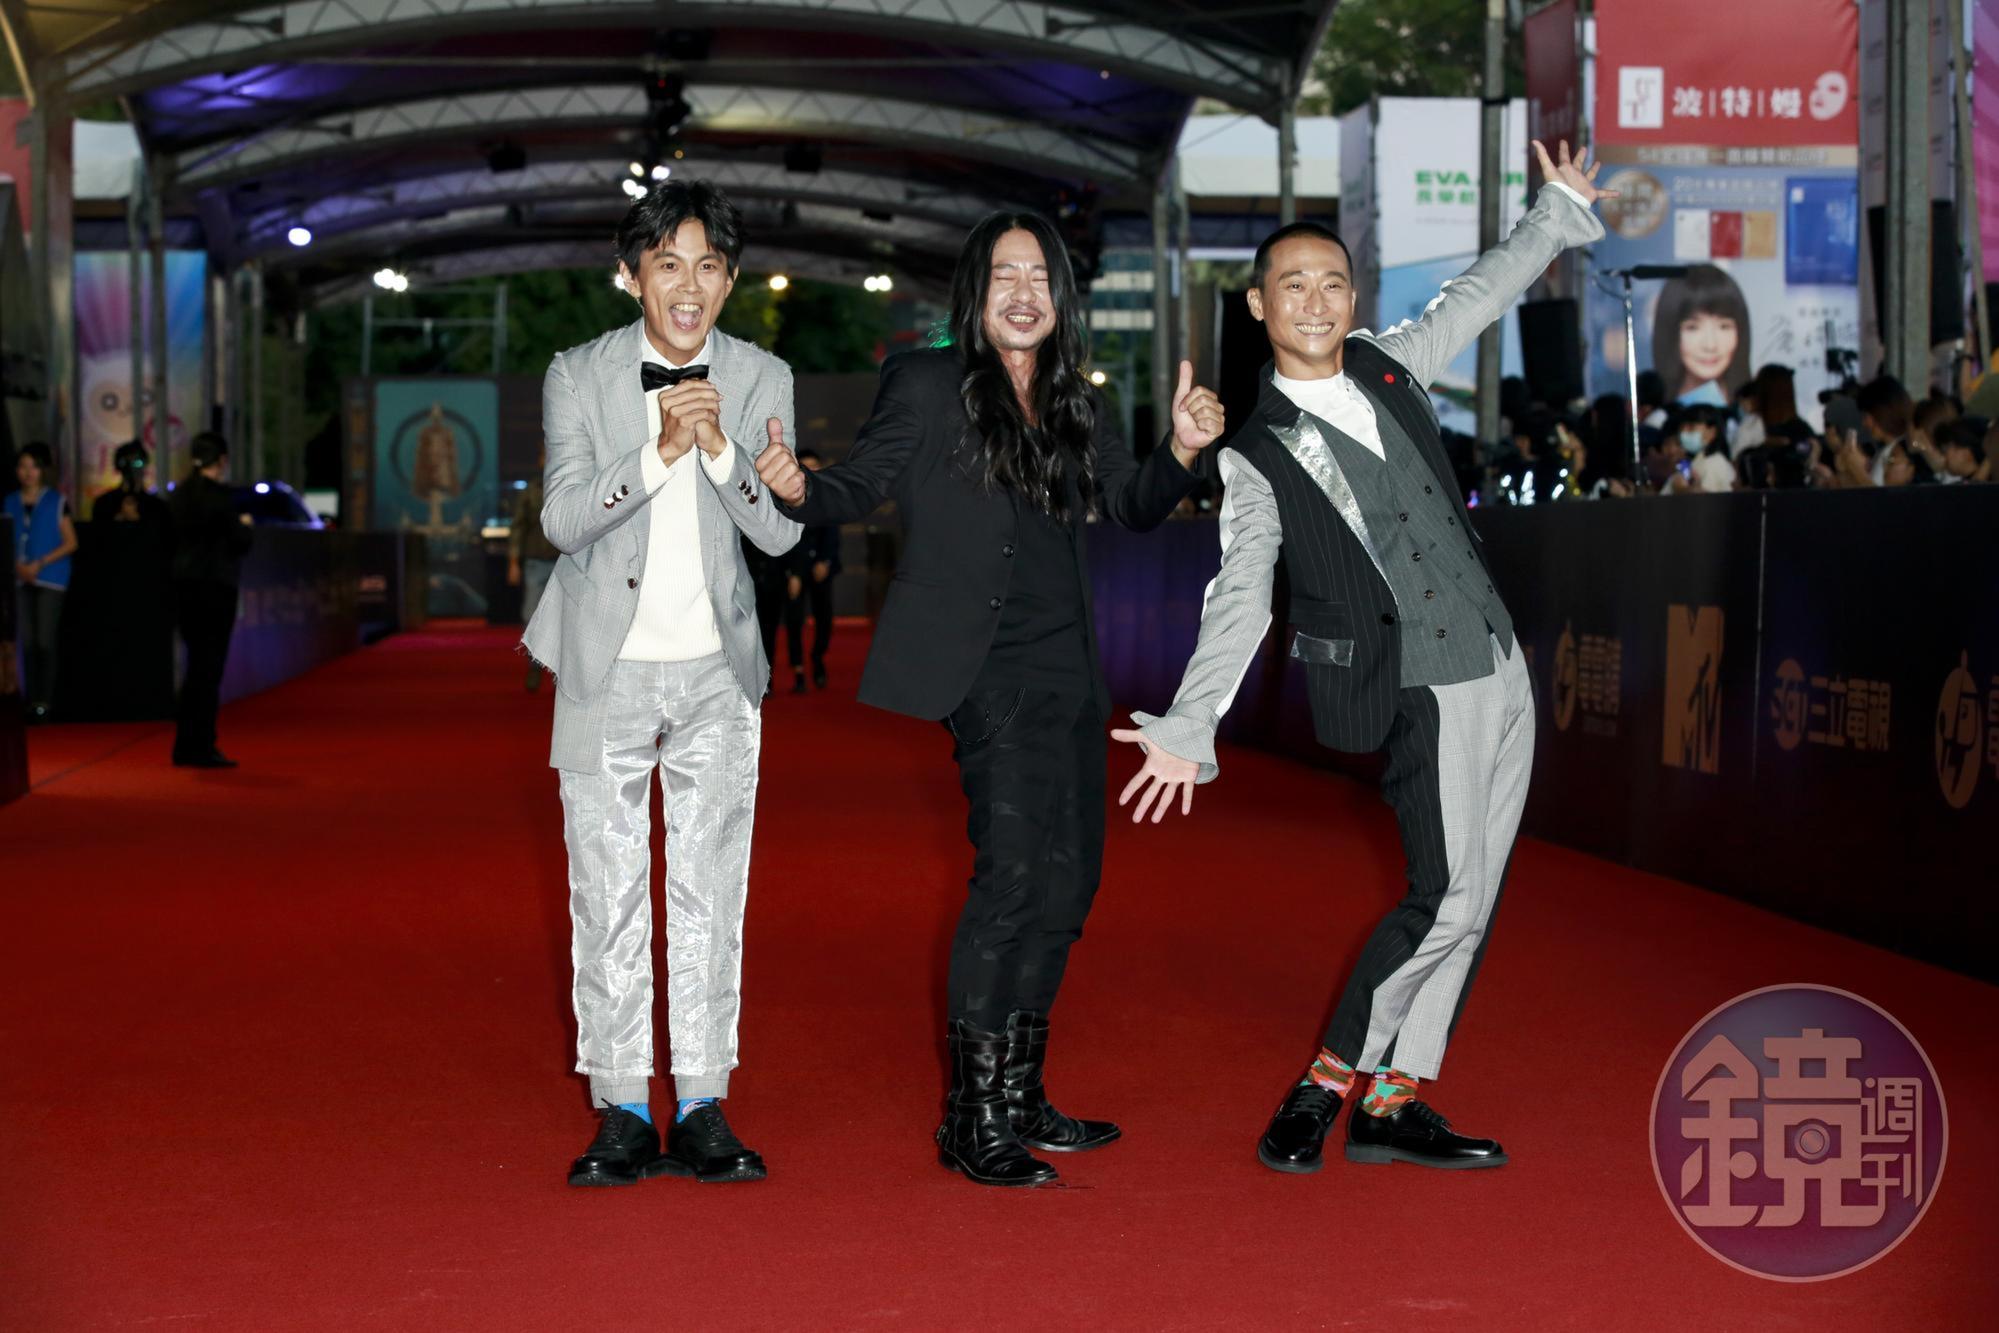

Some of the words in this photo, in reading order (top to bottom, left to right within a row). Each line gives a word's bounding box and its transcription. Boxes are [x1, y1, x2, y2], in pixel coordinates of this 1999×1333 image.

[1416, 171, 1470, 185] EVA
[1663, 604, 1724, 775] MTV
[1808, 673, 1891, 752] 三立電視
